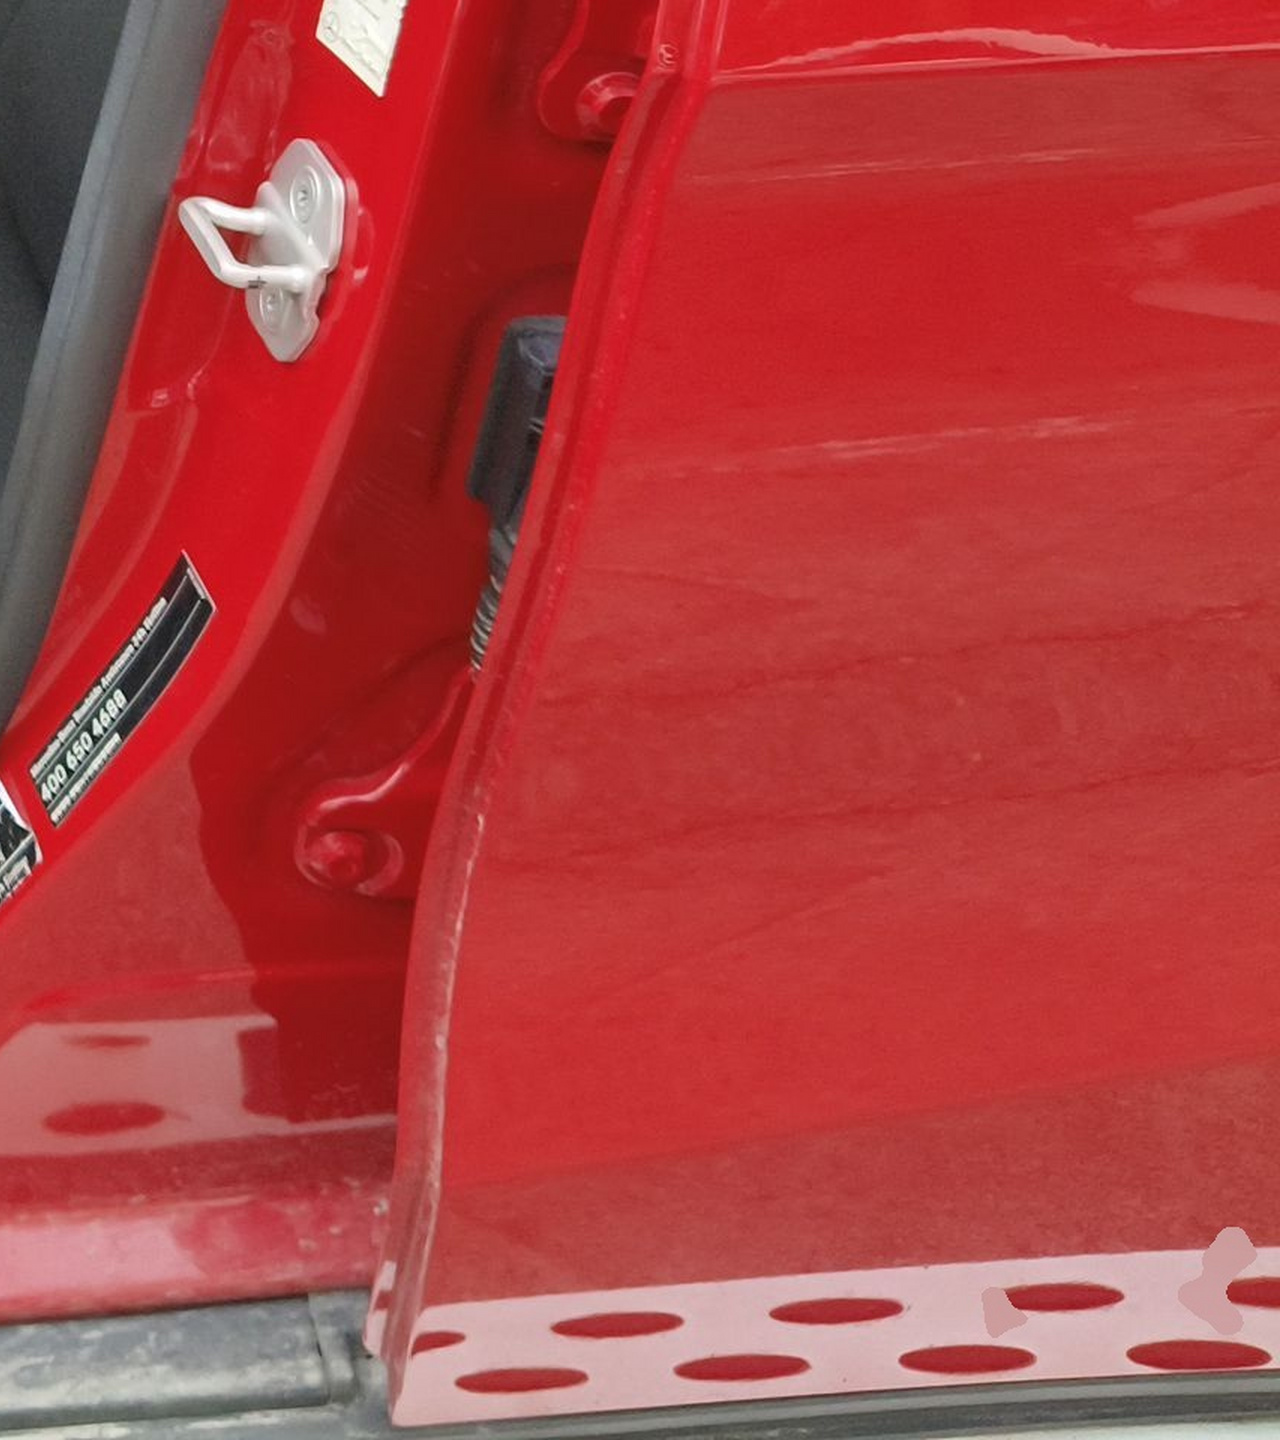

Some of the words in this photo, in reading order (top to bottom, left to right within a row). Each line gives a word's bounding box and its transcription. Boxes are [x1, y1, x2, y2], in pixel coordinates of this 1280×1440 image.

[41, 766, 67, 802] 400
[66, 732, 91, 771] 650
[92, 689, 127, 736] 4688
